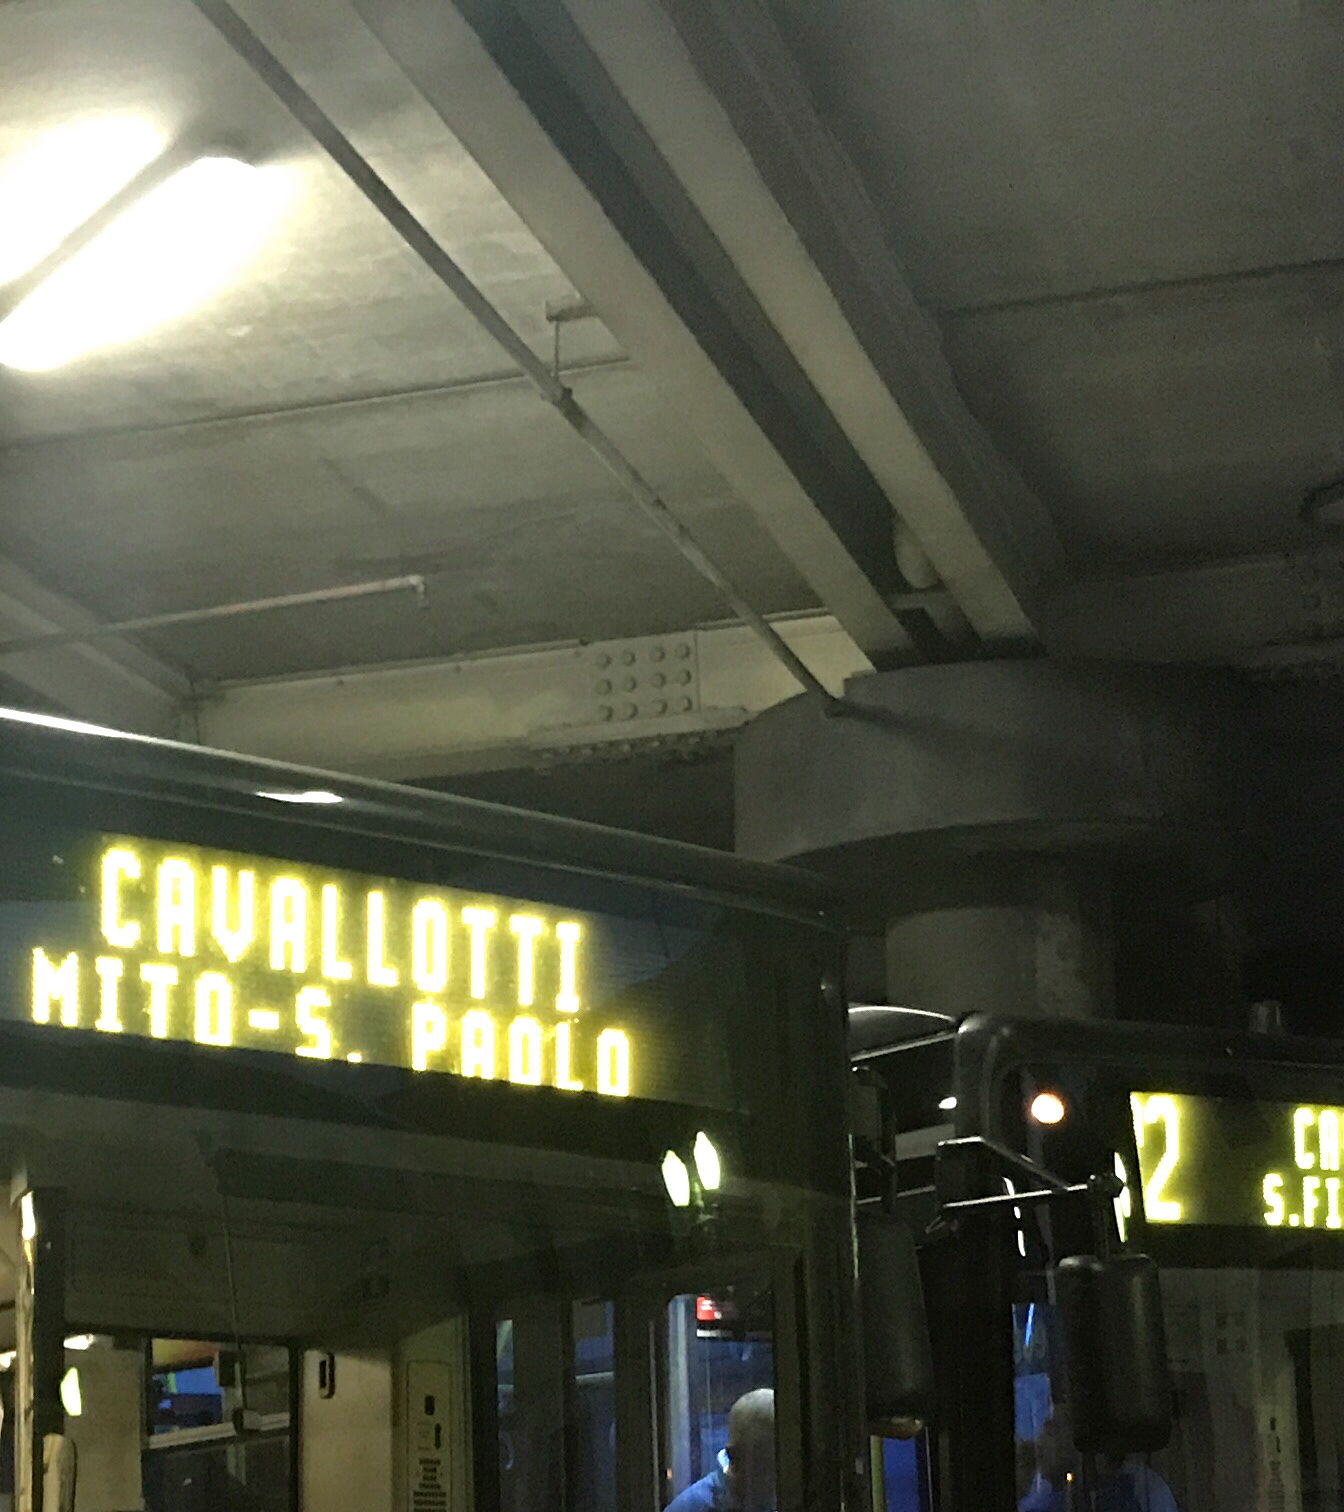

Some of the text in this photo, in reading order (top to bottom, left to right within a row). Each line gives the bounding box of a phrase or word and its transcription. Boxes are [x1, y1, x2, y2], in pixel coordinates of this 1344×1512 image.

[101, 847, 581, 1013] CAVALLOTTI
[411, 998, 630, 1097] PAOLO
[1130, 1094, 1182, 1221] 2
